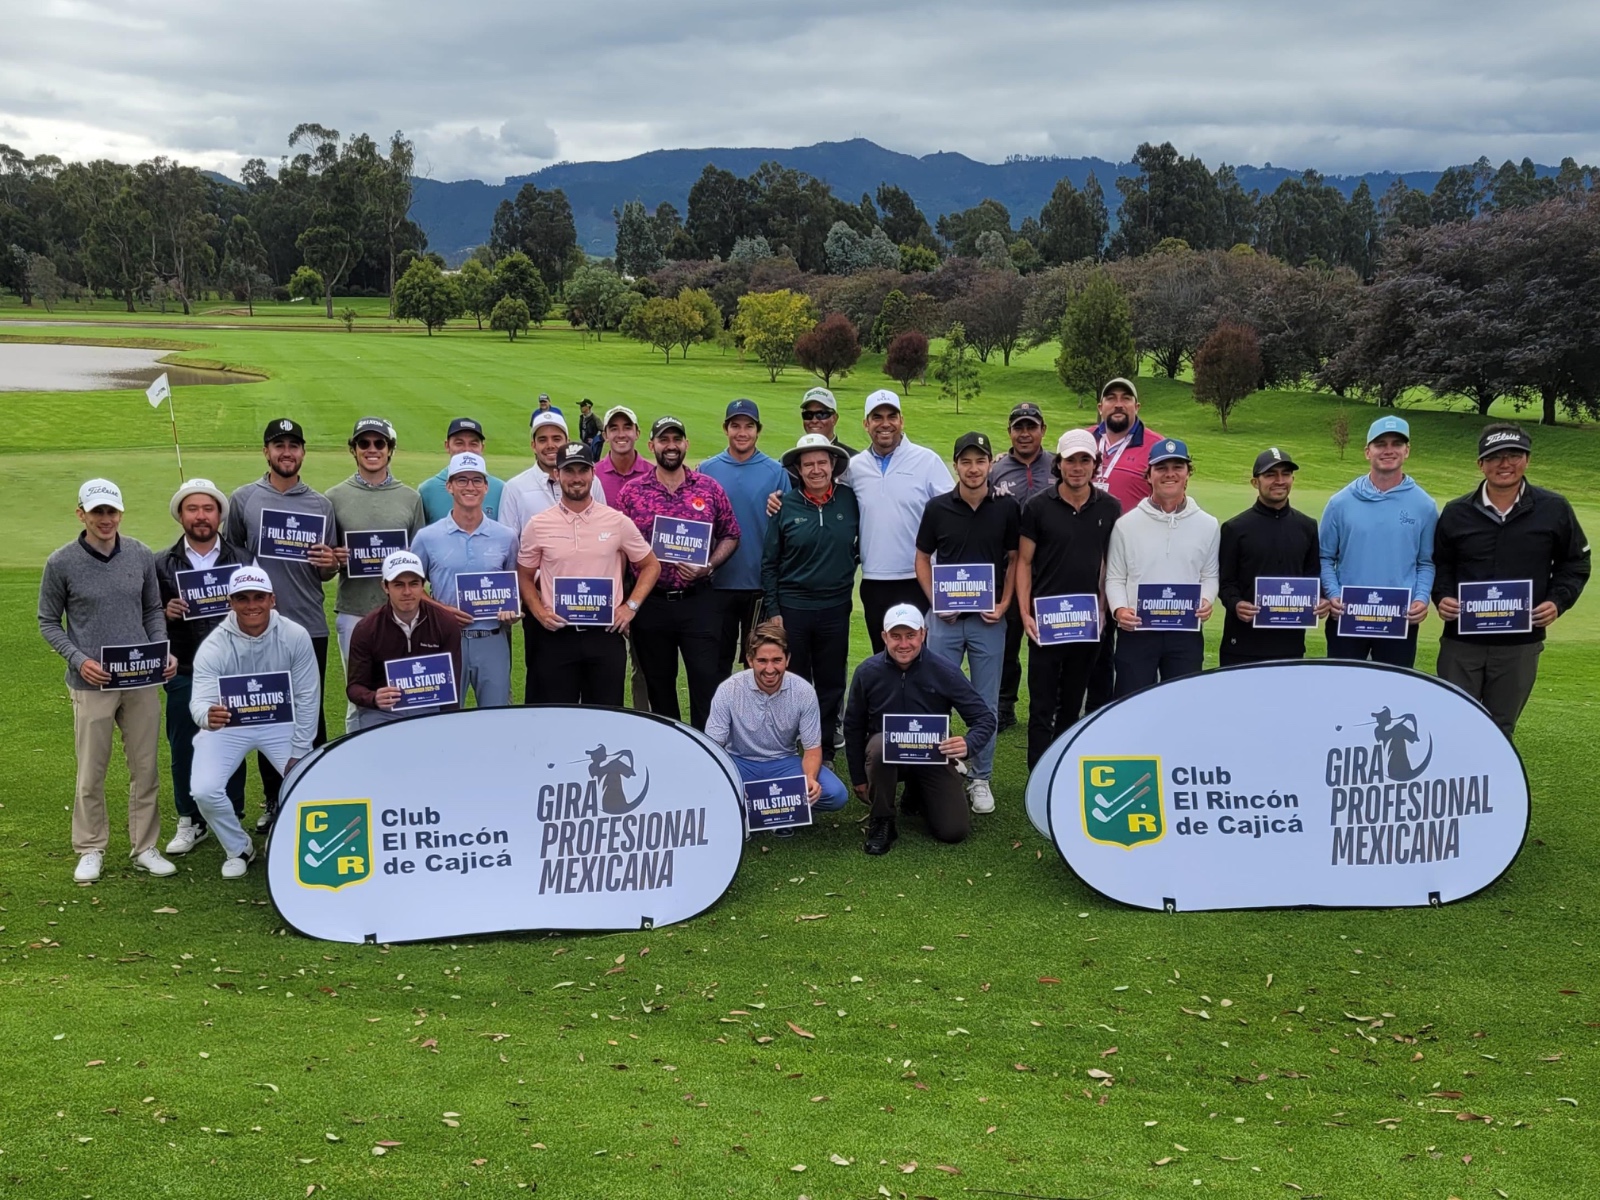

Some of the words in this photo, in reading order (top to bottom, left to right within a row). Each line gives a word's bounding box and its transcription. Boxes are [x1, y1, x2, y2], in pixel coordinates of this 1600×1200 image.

[357, 419, 383, 431] SRIXON
[1485, 432, 1520, 446] Titleist
[86, 485, 119, 498] Titleist
[267, 527, 285, 540] FULL
[286, 530, 317, 543] STATUS
[659, 532, 674, 544] FULL
[675, 536, 702, 549] STATUS
[354, 548, 371, 559] FULL
[389, 557, 418, 569] Titleist
[233, 574, 265, 587] Titleist
[939, 580, 987, 593] CONDITIONAL
[187, 588, 206, 601] FULL
[206, 585, 230, 598] STAT
[464, 589, 481, 601] FULL
[482, 588, 511, 600] STATUS
[561, 594, 577, 605] FULL
[578, 595, 606, 606] STATUS
[1262, 595, 1312, 607] CONDITIONAL
[1142, 599, 1193, 610] CONDITIONAL
[1347, 603, 1401, 617] CONDITIONAL
[1466, 599, 1523, 612] CONDITIONAL
[1043, 611, 1092, 624] CONDITIONAL
[110, 662, 128, 672] FULL
[130, 658, 160, 671] STATUS
[395, 677, 413, 690] FULL
[414, 672, 446, 687] STATUS
[228, 695, 247, 708] FULL
[249, 691, 284, 706] STATUS
[890, 731, 941, 744] CONDITIONAL
[1325, 744, 1384, 787] GIRA
[1090, 766, 1115, 787] C
[1171, 766, 1231, 785] Club
[536, 780, 598, 823] GIRA
[753, 798, 770, 811] FULL
[771, 794, 801, 808] STATUS
[1174, 792, 1199, 811] El
[1207, 789, 1299, 809] Rincón
[1330, 775, 1494, 826] PROFESIONAL
[305, 811, 329, 833] C
[381, 807, 441, 827] Club
[1128, 814, 1157, 832] R
[540, 808, 709, 859] PROFESIONAL
[1176, 817, 1208, 836] de
[1219, 813, 1304, 839] Cajicá
[383, 832, 406, 851] El
[415, 828, 509, 849] Rincón
[1331, 819, 1460, 866] MEXICANA
[337, 856, 365, 875] R
[383, 857, 415, 875] de
[425, 849, 512, 874] Cajicá
[538, 850, 673, 895] MEXICANA
